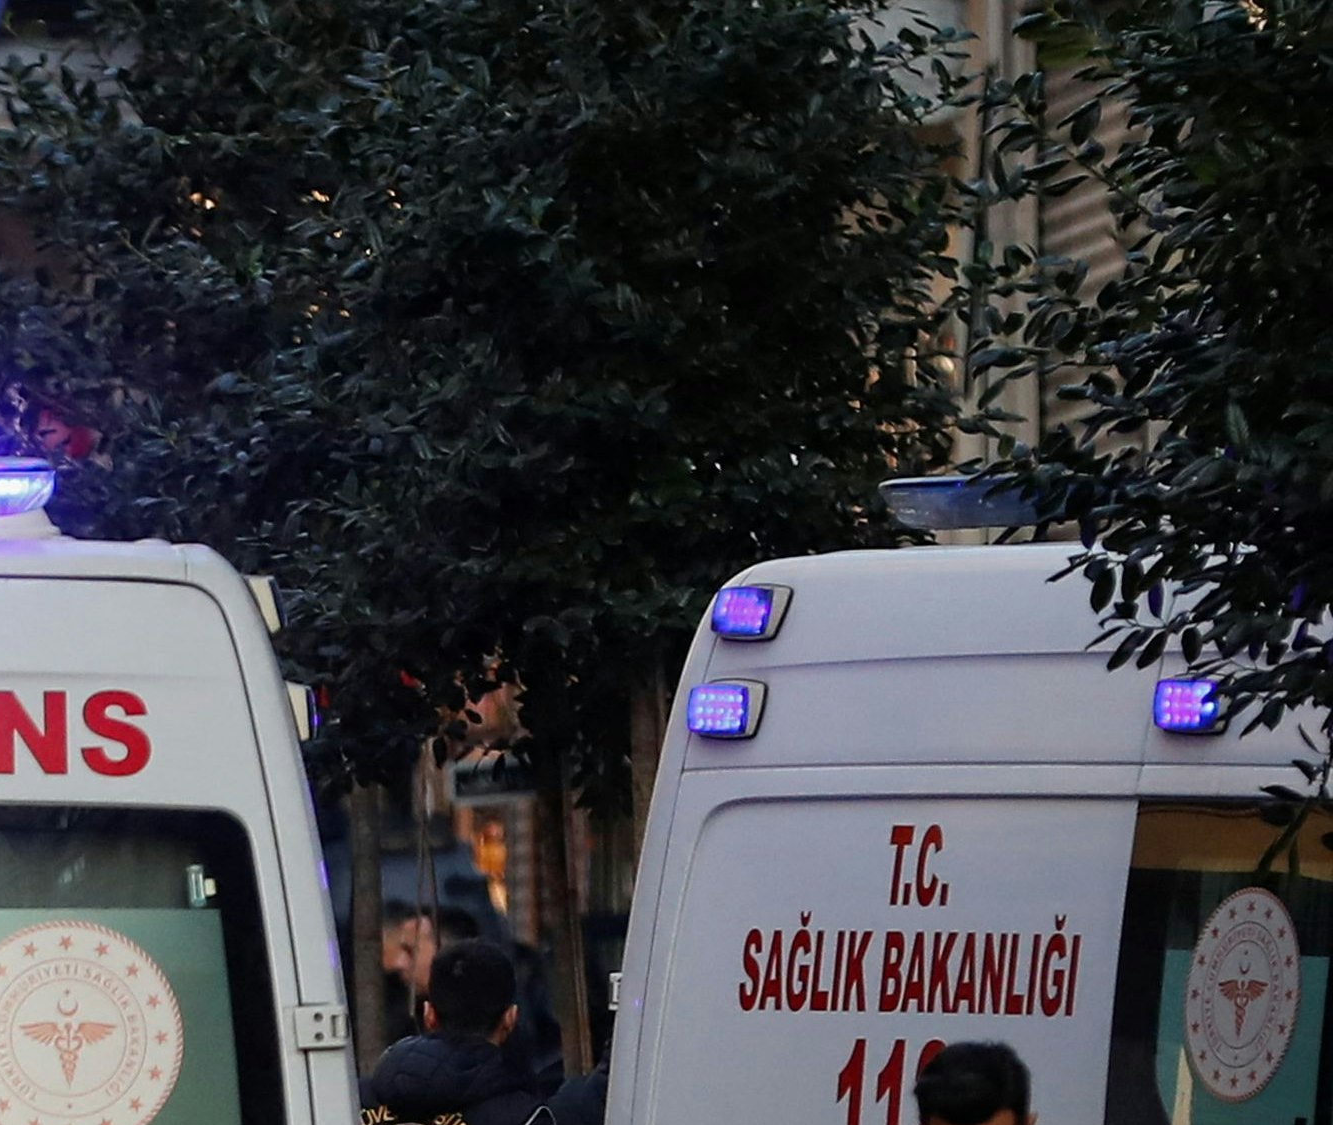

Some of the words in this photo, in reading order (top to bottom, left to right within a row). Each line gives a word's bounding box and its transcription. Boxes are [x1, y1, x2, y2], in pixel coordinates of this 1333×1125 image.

[889, 824, 949, 907] T.C.
[738, 911, 874, 1012] SAĞLIK
[878, 914, 1082, 1017] BAKANLIĞI
